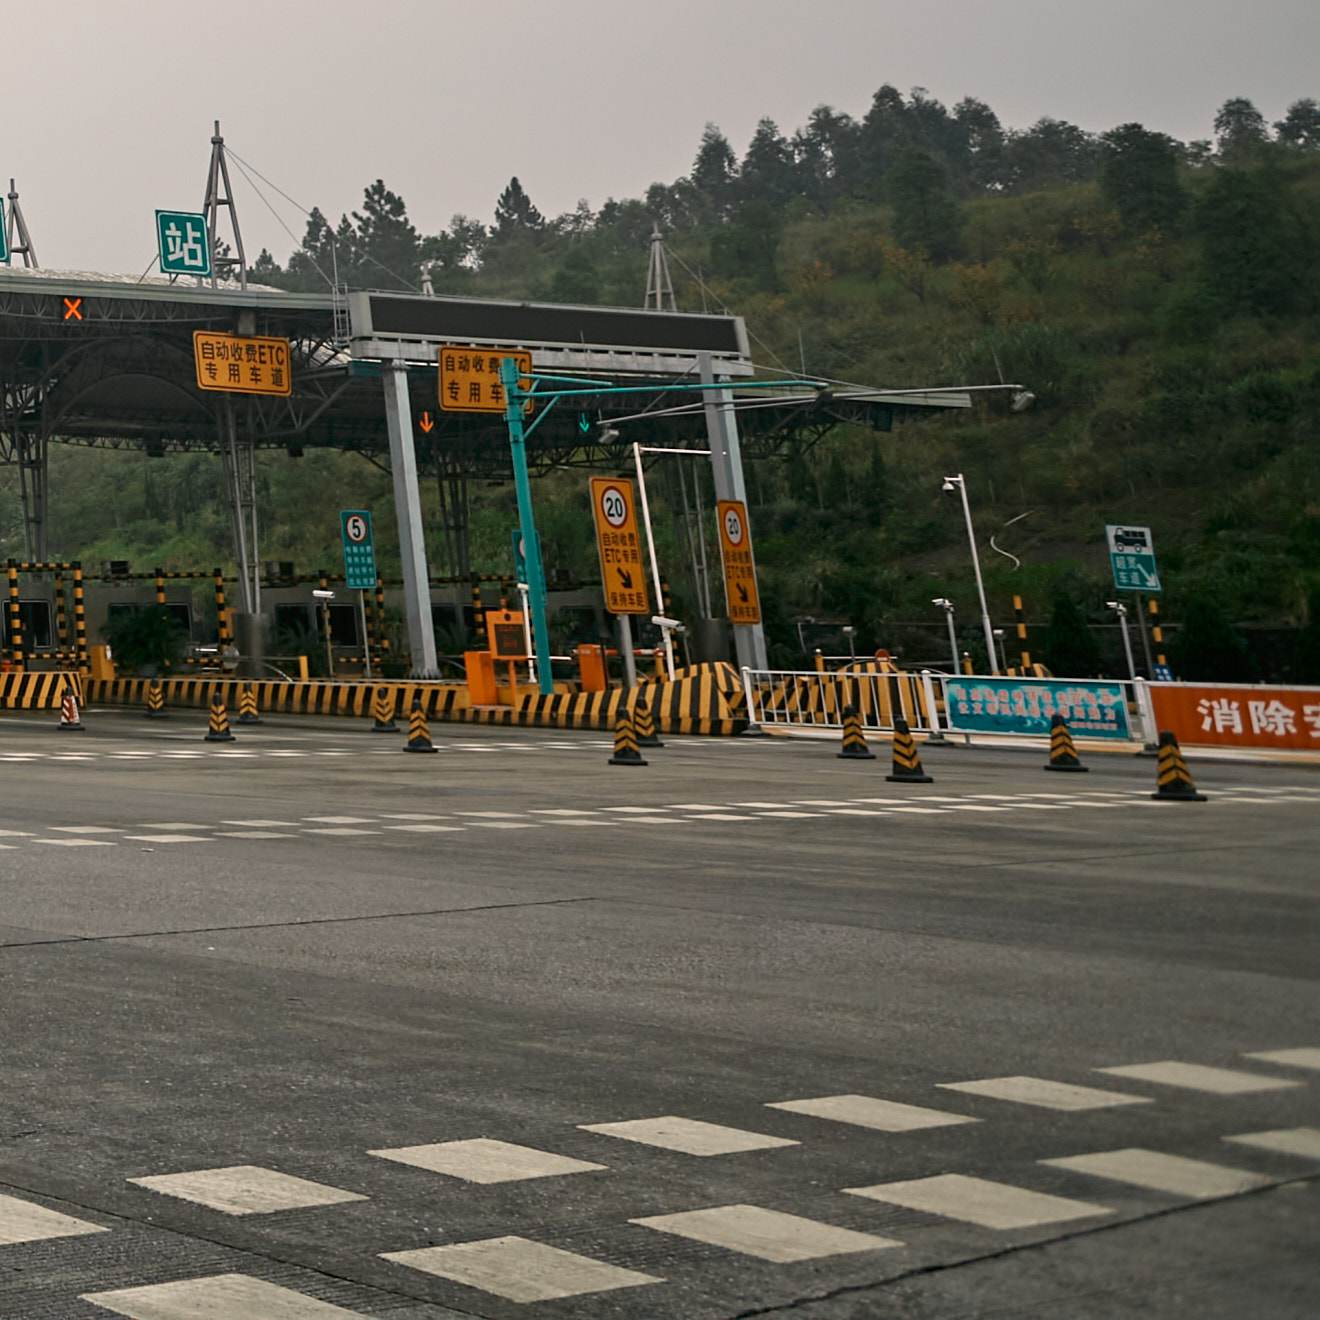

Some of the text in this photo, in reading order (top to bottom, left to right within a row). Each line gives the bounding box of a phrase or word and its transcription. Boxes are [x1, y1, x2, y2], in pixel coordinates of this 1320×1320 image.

[165, 221, 203, 267] 站
[205, 361, 284, 387] 专用车道
[447, 380, 524, 404] 专用车
[605, 497, 623, 518] 20
[352, 518, 361, 539] 5
[727, 518, 739, 535] 20
